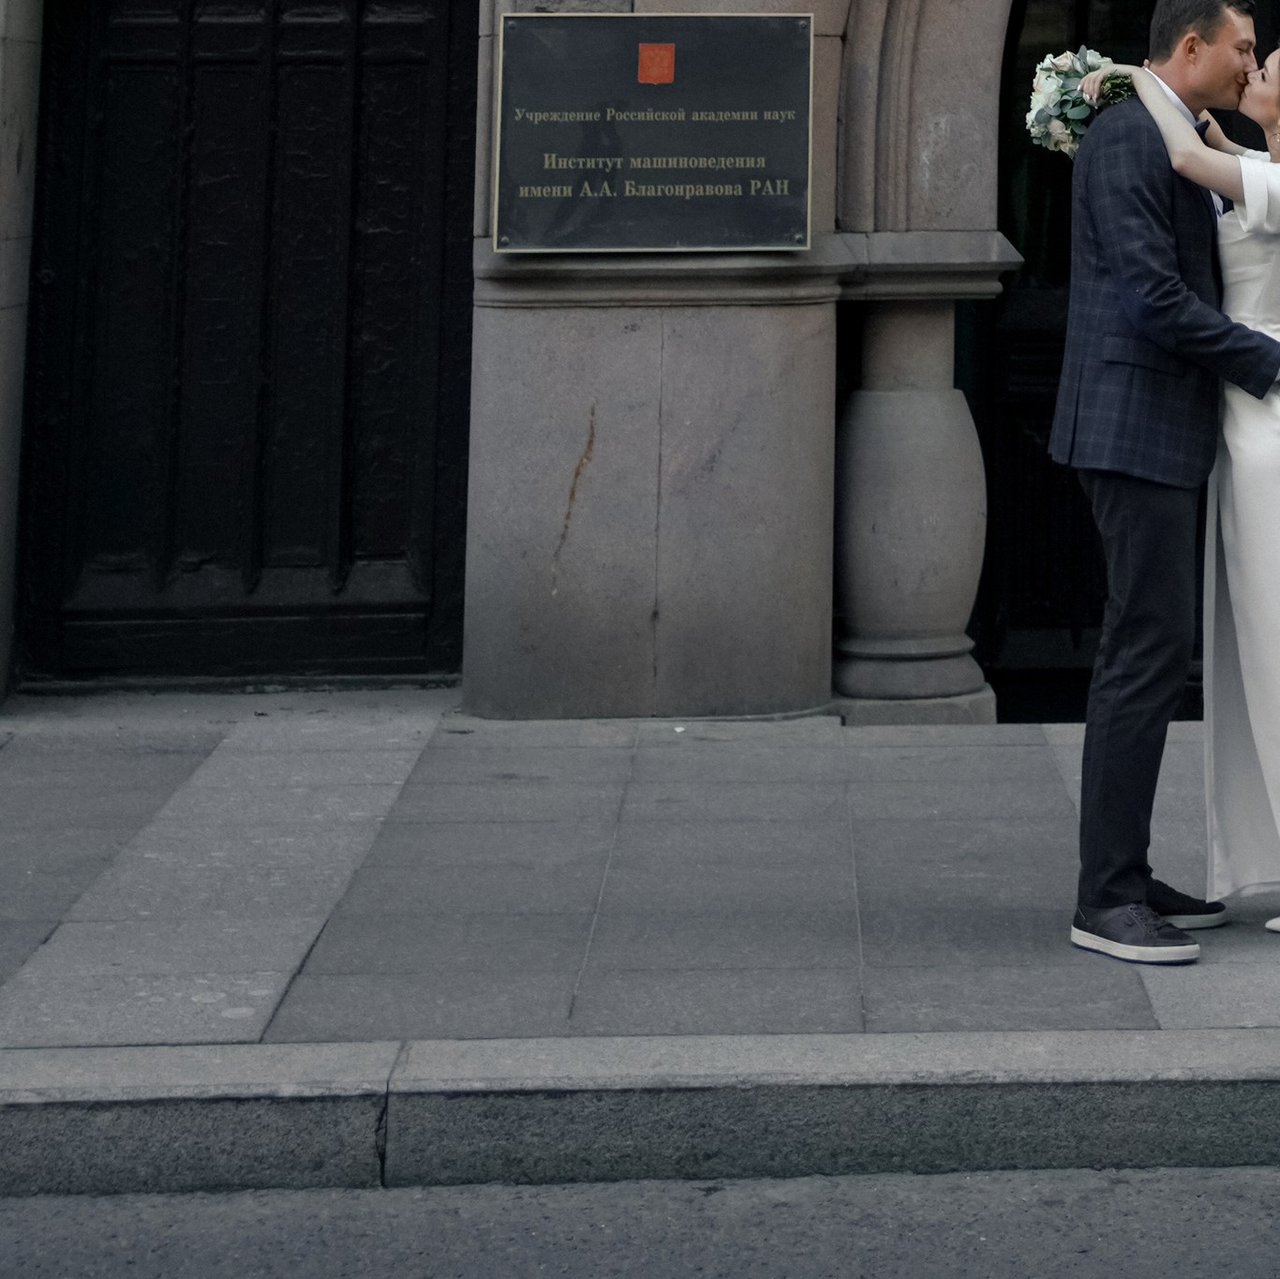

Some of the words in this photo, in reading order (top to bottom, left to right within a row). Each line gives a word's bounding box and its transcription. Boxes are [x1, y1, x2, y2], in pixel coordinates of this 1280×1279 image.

[515, 108, 600, 125] Учреждение
[606, 107, 686, 122] Российской
[691, 109, 758, 123] академии
[763, 109, 796, 123] наук
[543, 153, 623, 173] Институт
[630, 156, 766, 171] машиноведения
[519, 185, 572, 197] имени
[579, 180, 617, 197] А.А.
[624, 179, 742, 200] Благонравова
[750, 179, 790, 196] РАН
